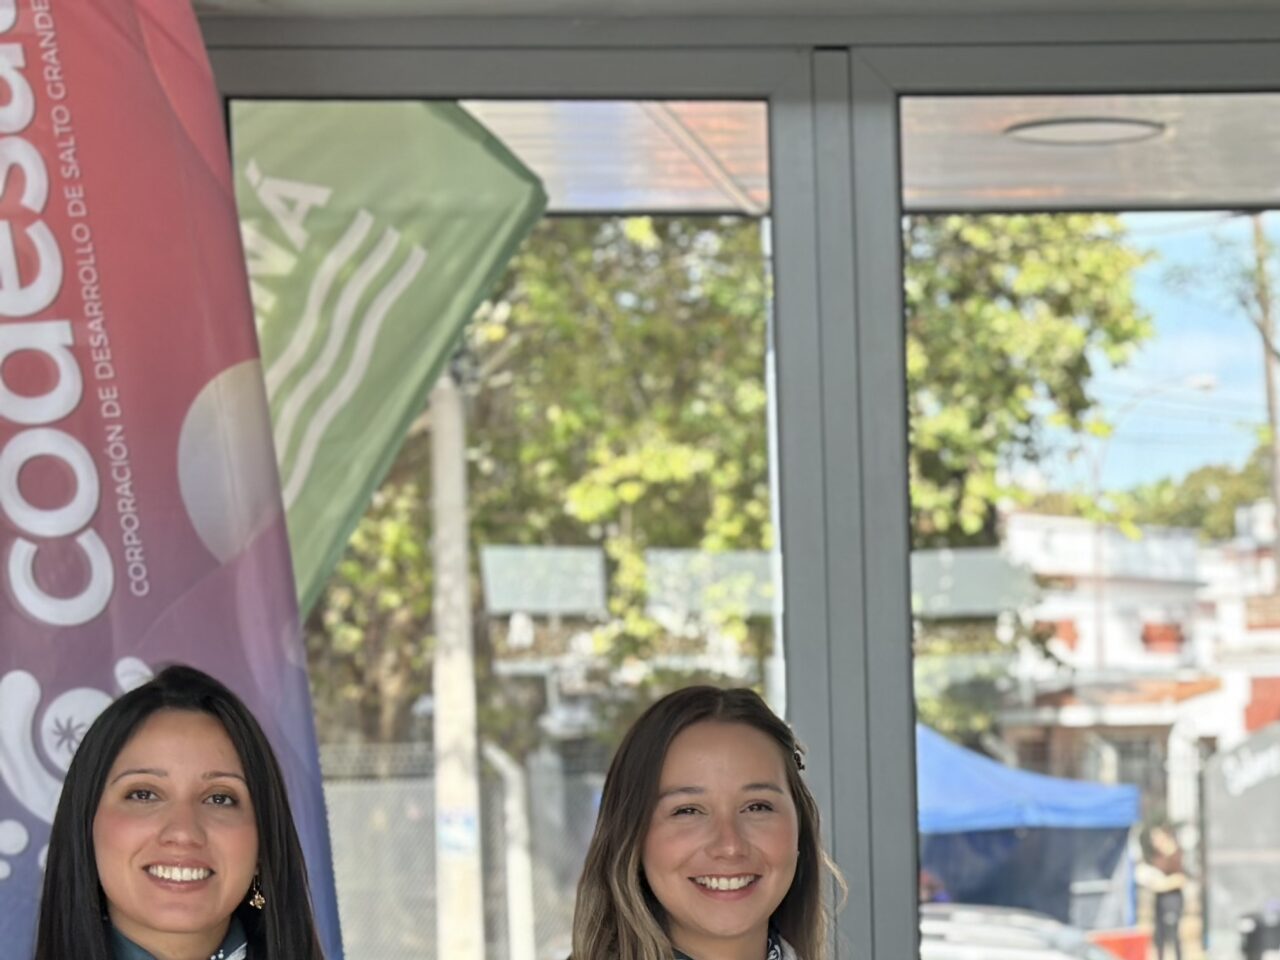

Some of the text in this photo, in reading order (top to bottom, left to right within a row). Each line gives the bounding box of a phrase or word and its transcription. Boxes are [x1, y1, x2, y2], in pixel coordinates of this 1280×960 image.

[0, 0, 114, 626] code
[32, 0, 150, 597] CORPORACIÓN DE DESARROLLO DE SALTO GRANDE
